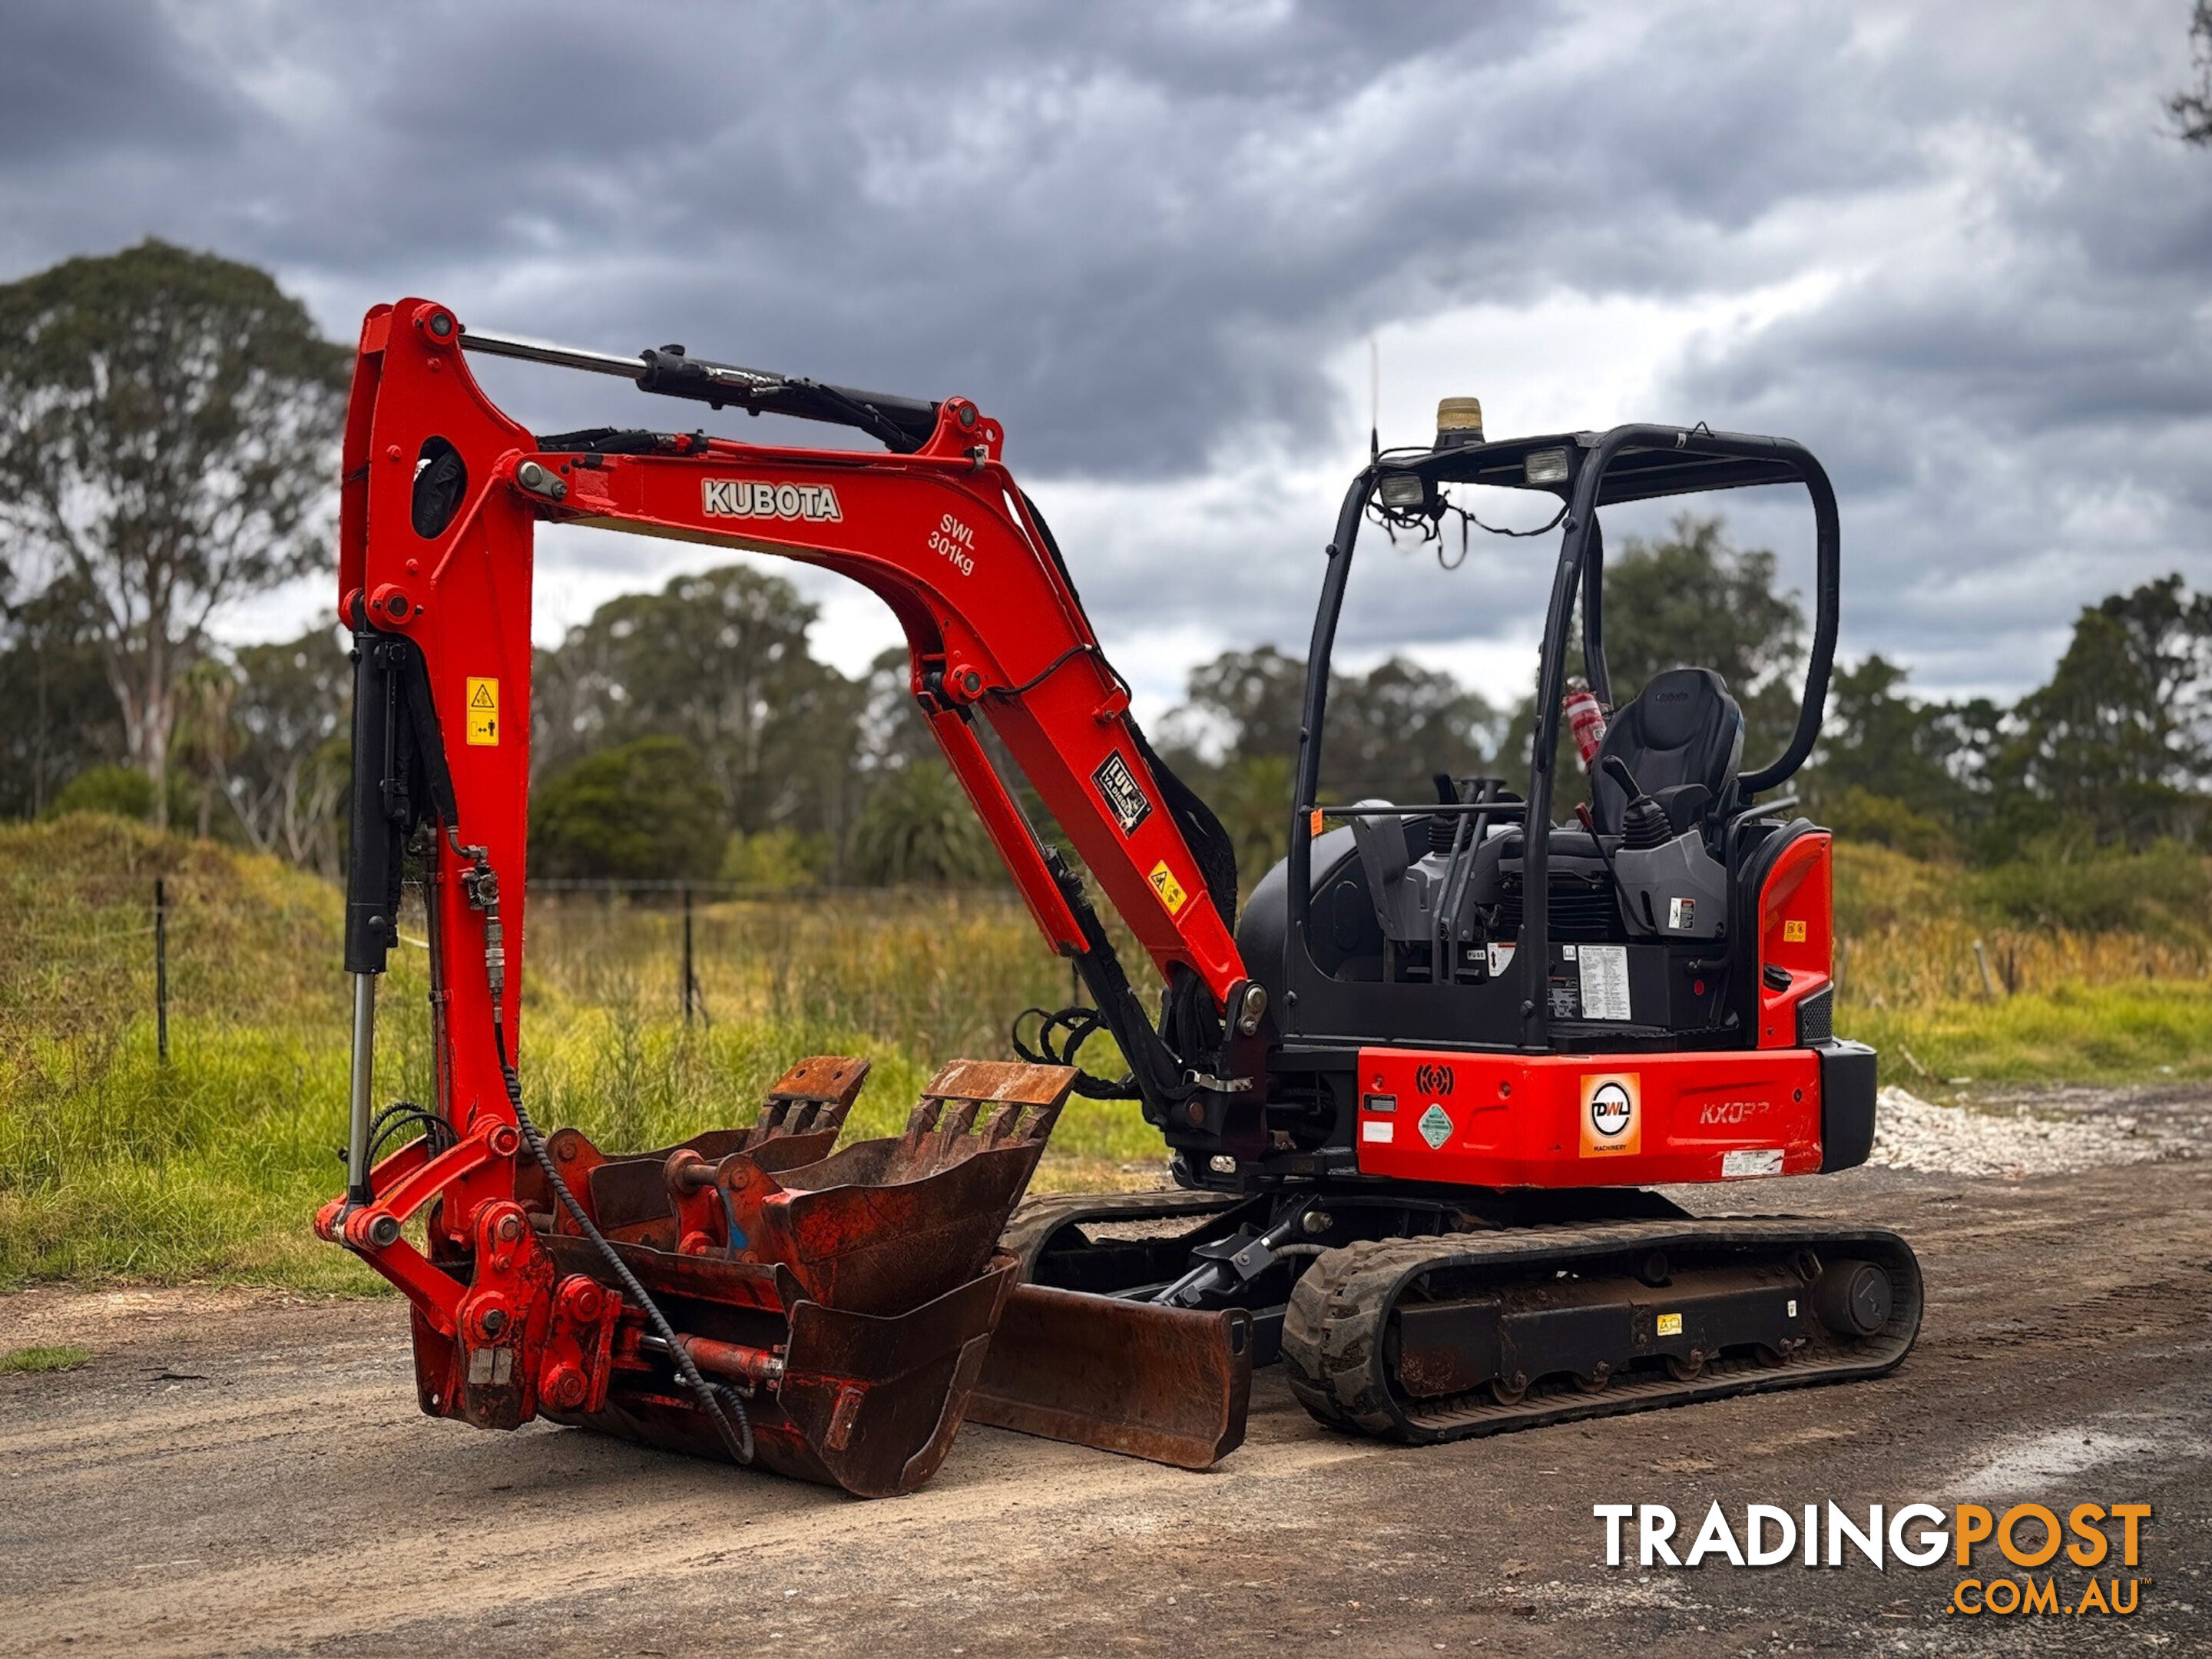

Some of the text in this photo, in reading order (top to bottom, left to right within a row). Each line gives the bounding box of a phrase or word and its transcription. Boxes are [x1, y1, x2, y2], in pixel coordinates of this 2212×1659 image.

[702, 478, 842, 521] KUBOTA
[939, 513, 976, 550] SWL
[927, 530, 975, 577] 301kg
[1108, 762, 1134, 796] LUV
[1591, 1101, 1631, 1117] DWL
[1594, 1144, 1627, 1152] MACHINERY
